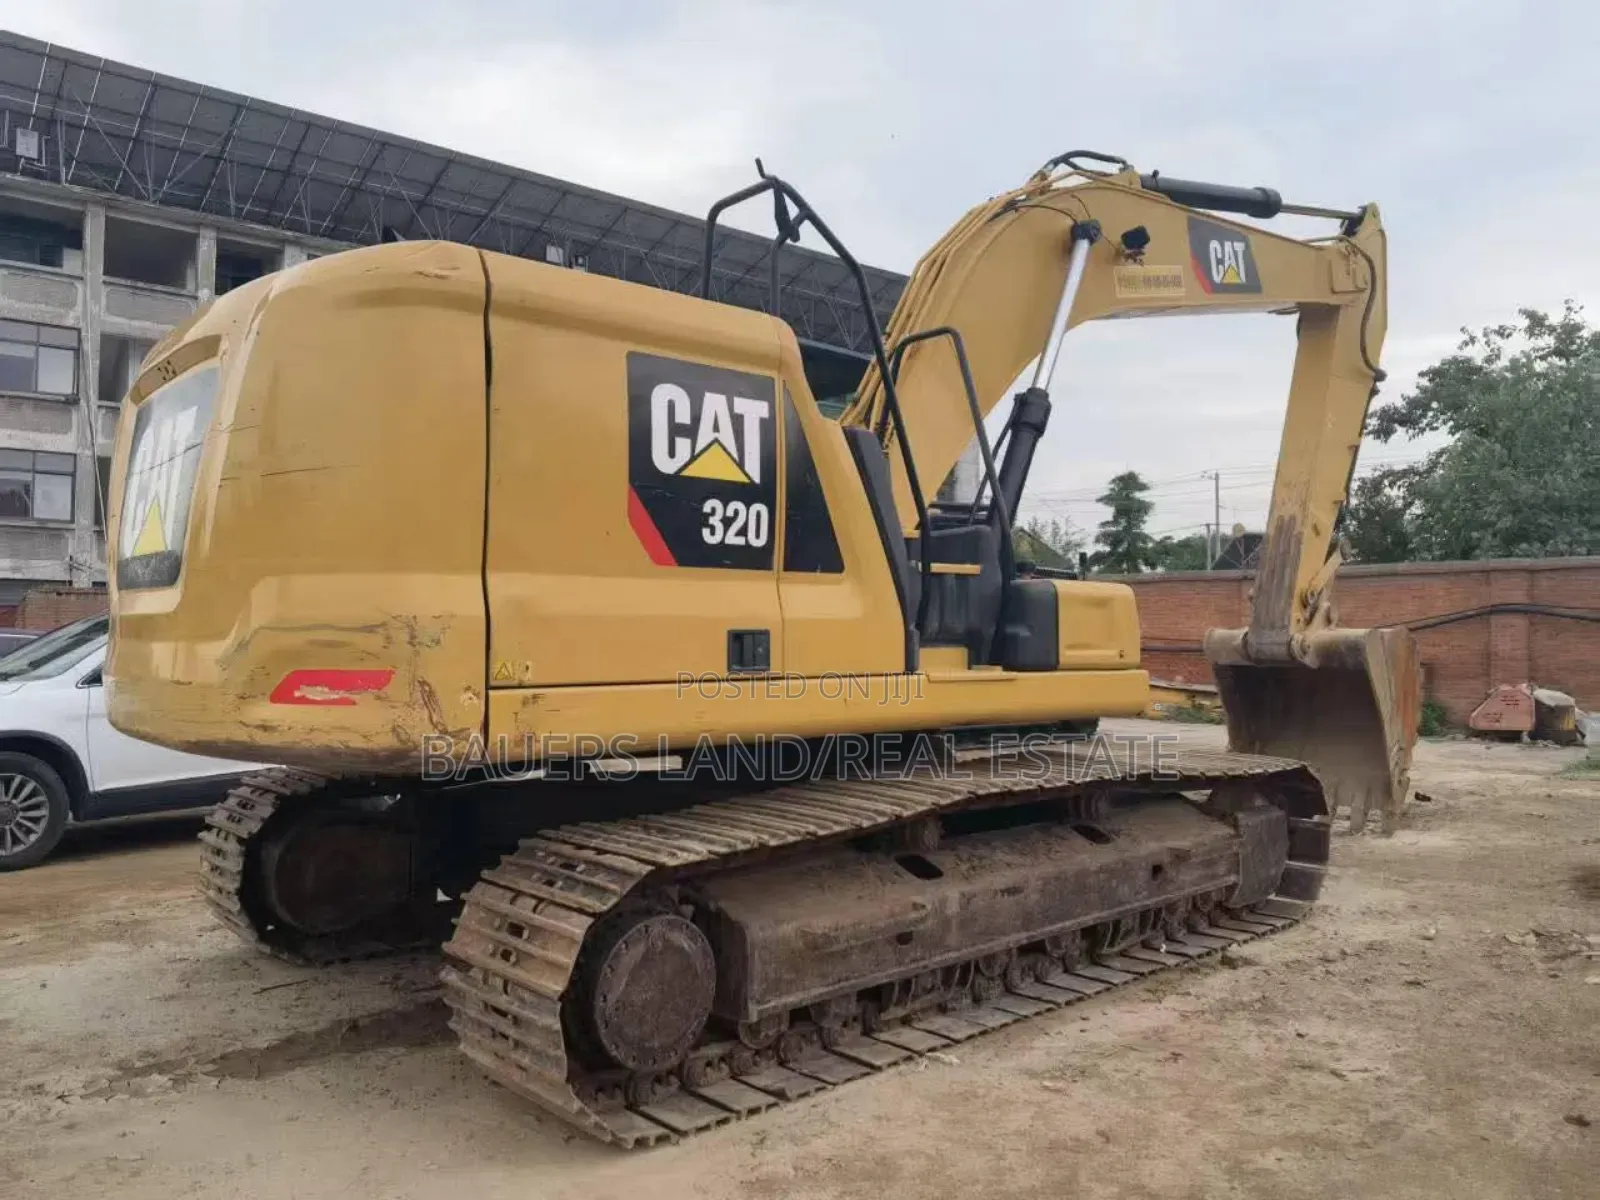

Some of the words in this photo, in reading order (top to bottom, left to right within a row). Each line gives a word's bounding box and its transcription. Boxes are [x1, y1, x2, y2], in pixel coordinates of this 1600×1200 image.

[1209, 239, 1246, 283] CAT
[650, 383, 769, 484] CAT
[701, 498, 769, 548] 320
